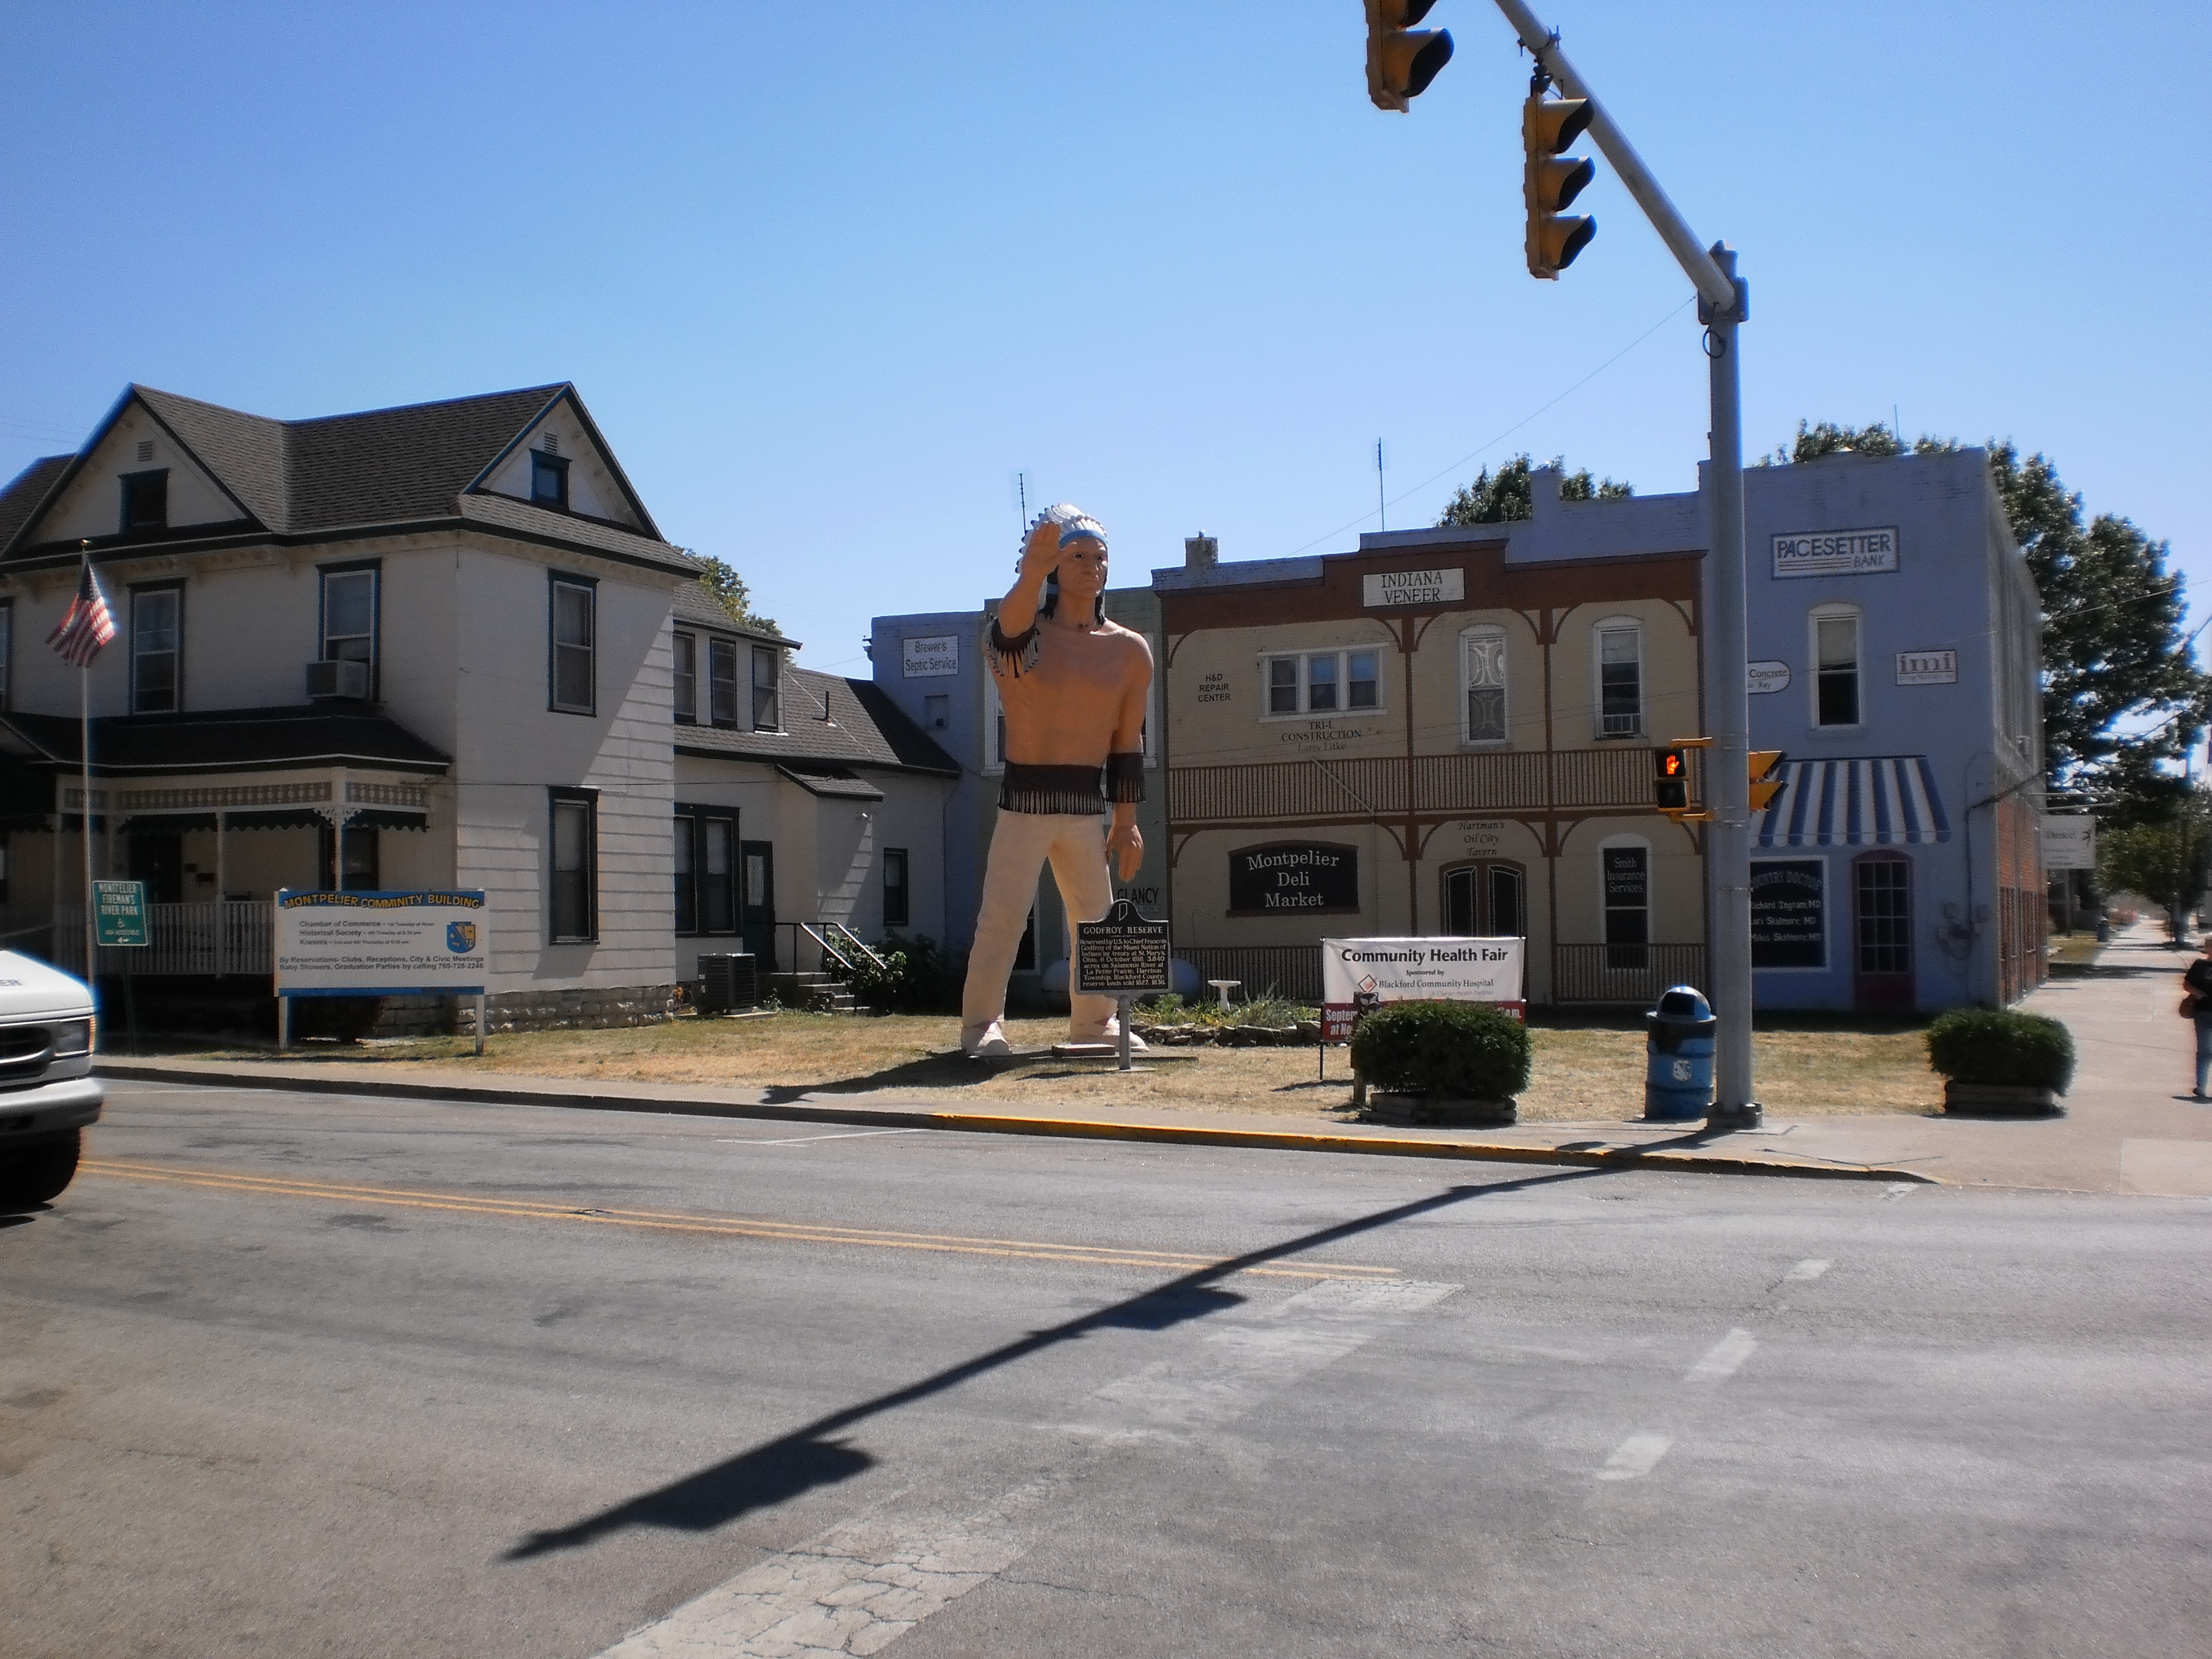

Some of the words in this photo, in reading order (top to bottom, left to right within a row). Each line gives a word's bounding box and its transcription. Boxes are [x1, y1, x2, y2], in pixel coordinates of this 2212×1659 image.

[1777, 534, 1891, 558] PACESETTER
[1855, 555, 1884, 567] BANK
[1381, 571, 1443, 588] INDIANA
[1385, 588, 1440, 604] VENEER
[915, 641, 947, 652] Brewer's
[905, 659, 928, 673] Septic
[929, 657, 957, 670] Service
[1899, 653, 1951, 672] imi
[1205, 673, 1223, 682] H&D
[1749, 669, 1788, 678] Concrete
[1199, 683, 1230, 692] REPAIR
[1198, 693, 1231, 702] CENTER
[1308, 721, 1335, 730] TRI-L
[1282, 729, 1362, 742] CONSTRUCTION
[1458, 820, 1505, 831] Hartman's
[1464, 833, 1479, 843] Oil
[1480, 833, 1500, 846] City
[1467, 847, 1497, 857] Tavern
[1246, 850, 1340, 871] Montpelier
[1614, 857, 1637, 868] Smith
[1277, 871, 1311, 886] Deli
[1607, 870, 1645, 881] Insurance
[1752, 871, 1784, 889] OUNTRY
[98, 884, 137, 893] MONTPELIER
[1609, 881, 1643, 892] Services
[103, 894, 135, 904] FIREMAN'S
[284, 894, 358, 909] MONTPELIER
[428, 893, 480, 909] BUILDING
[1264, 892, 1325, 908] Market
[1808, 900, 1822, 908] MD
[101, 905, 120, 915] RIVER
[120, 905, 138, 915] PARK
[1803, 916, 1816, 925] MD
[1083, 926, 1122, 934] GODFROY
[1808, 933, 1821, 941] MD
[1341, 948, 1426, 966] Community
[1430, 948, 1477, 962] Health
[1482, 948, 1508, 961] Fair
[1379, 979, 1415, 988] Blackford
[1417, 979, 1461, 989] Community
[1463, 978, 1494, 989] Hospital
[1330, 1024, 1340, 1035] at
